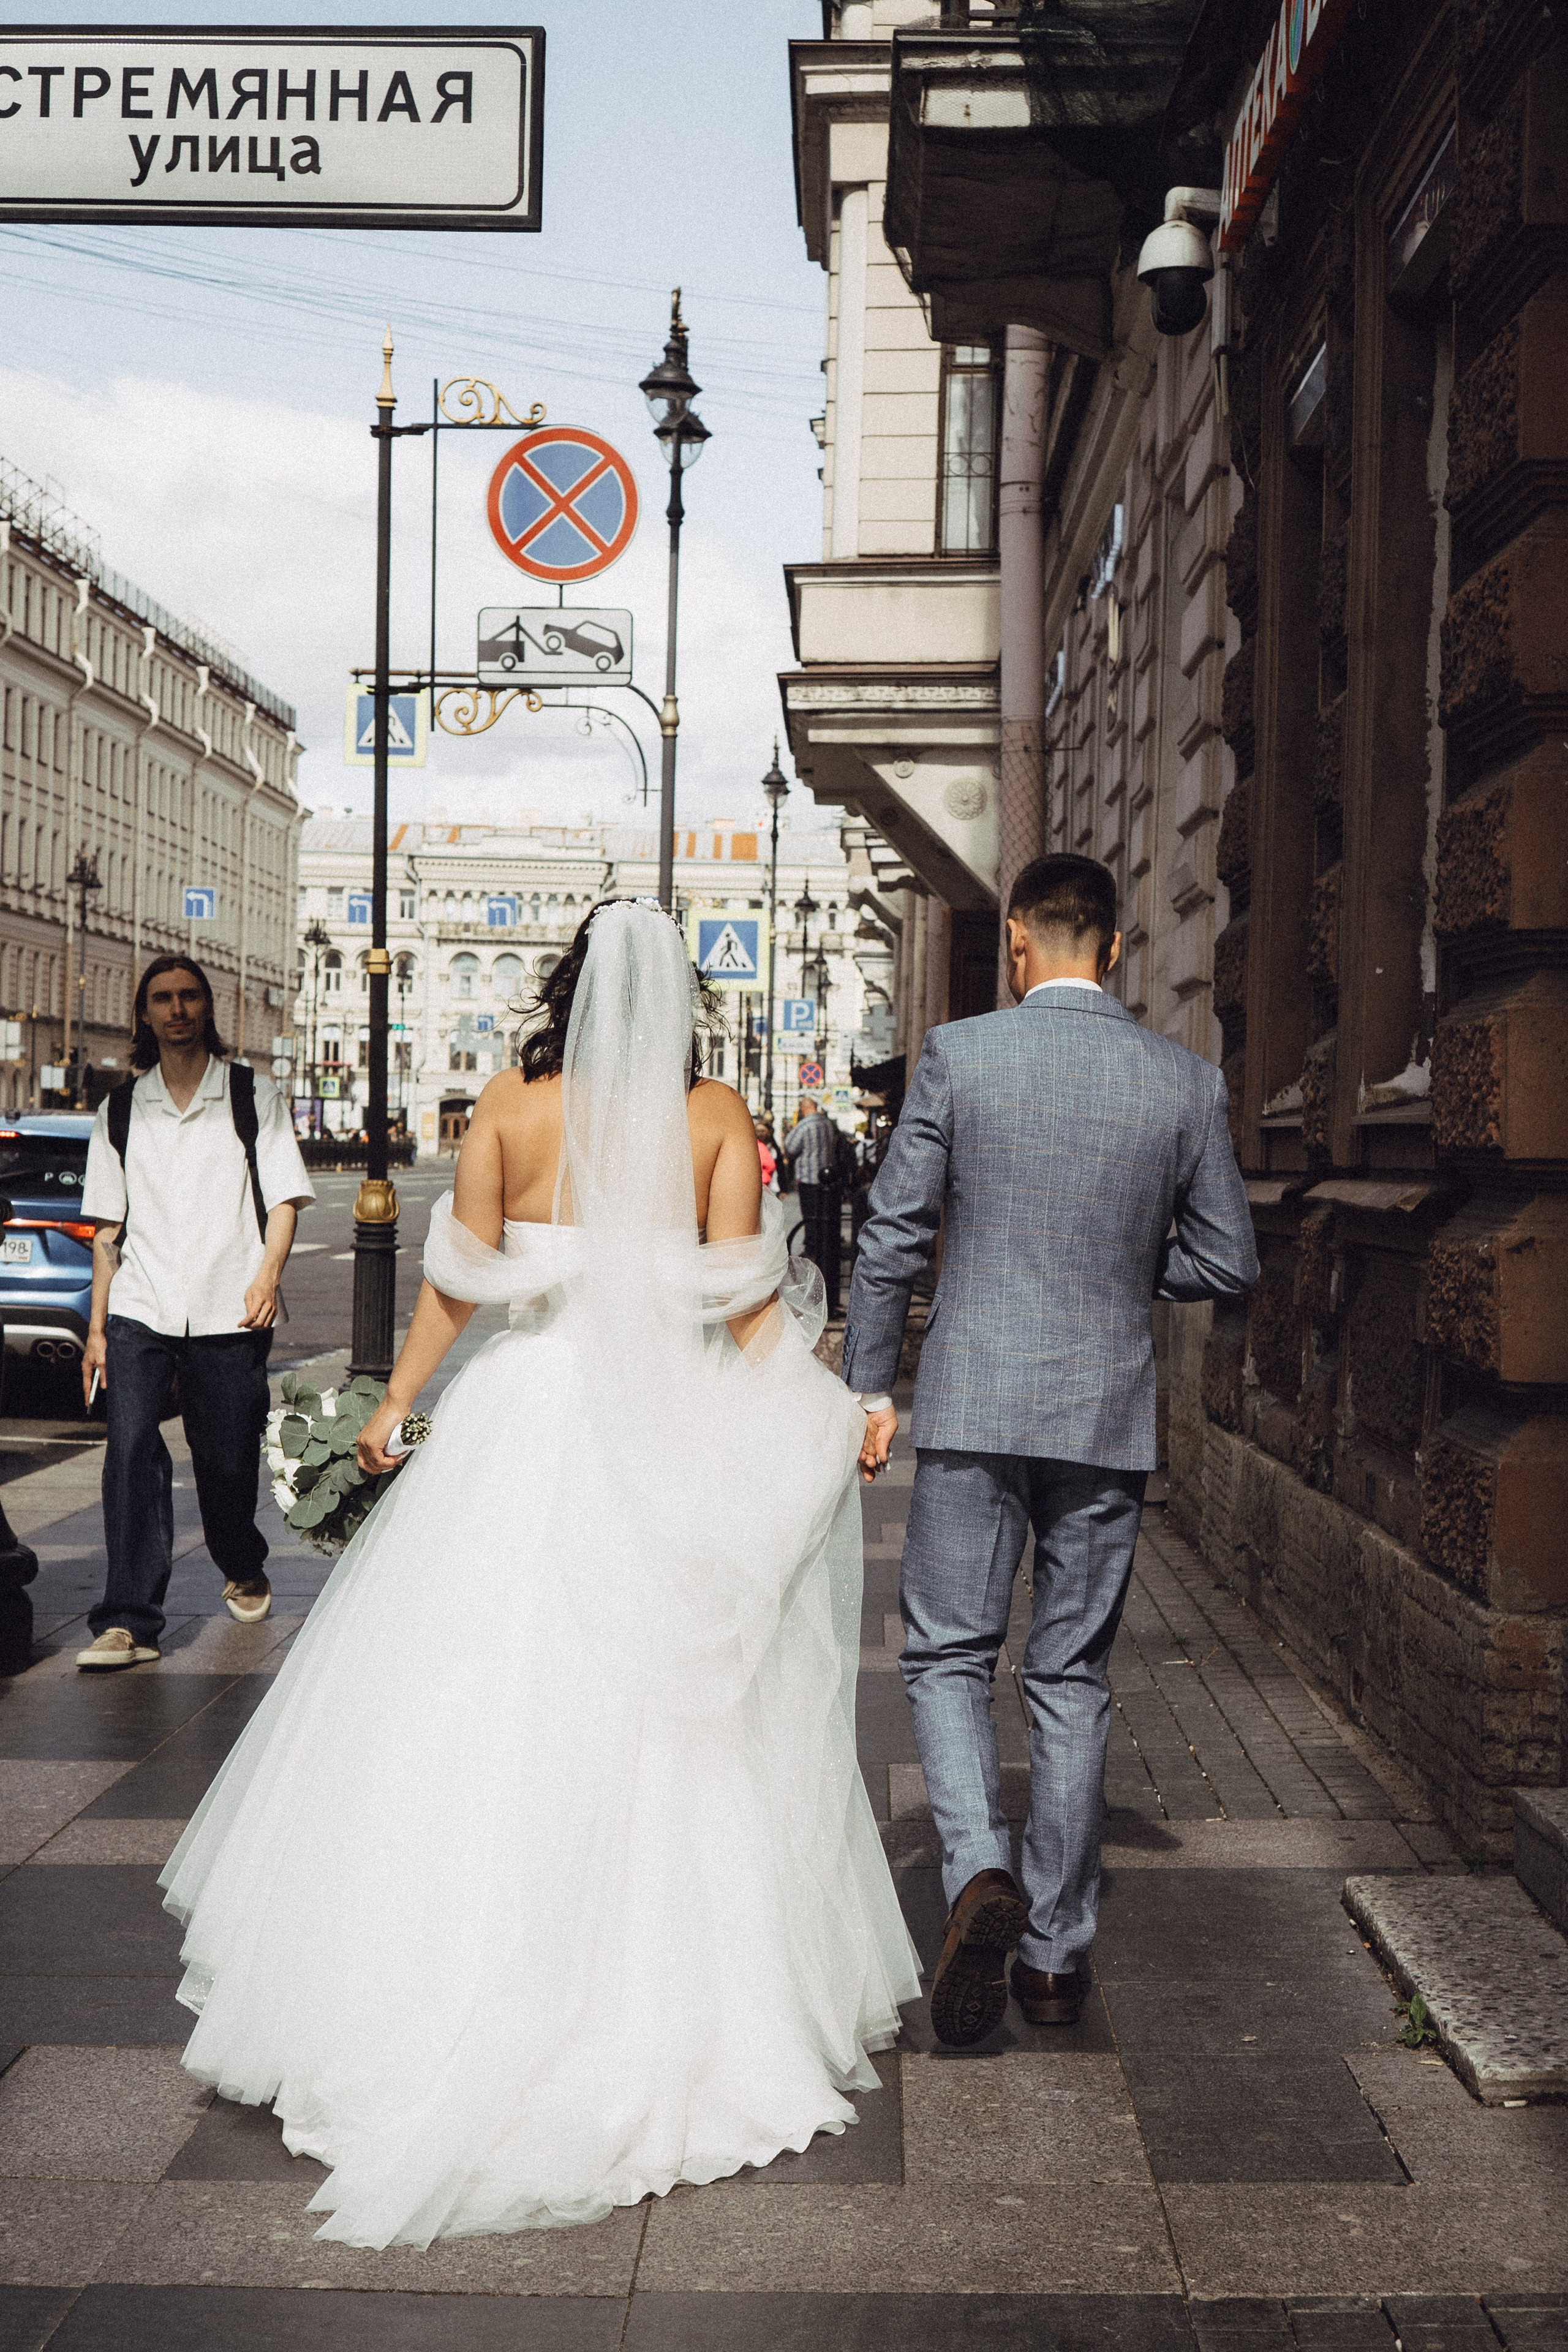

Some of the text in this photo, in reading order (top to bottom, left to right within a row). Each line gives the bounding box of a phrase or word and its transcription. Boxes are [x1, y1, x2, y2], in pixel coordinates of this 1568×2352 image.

[0, 65, 473, 123] СТРЕМЯННАЯ
[1218, 0, 1287, 247] АПТЕКА
[128, 134, 322, 187] улица
